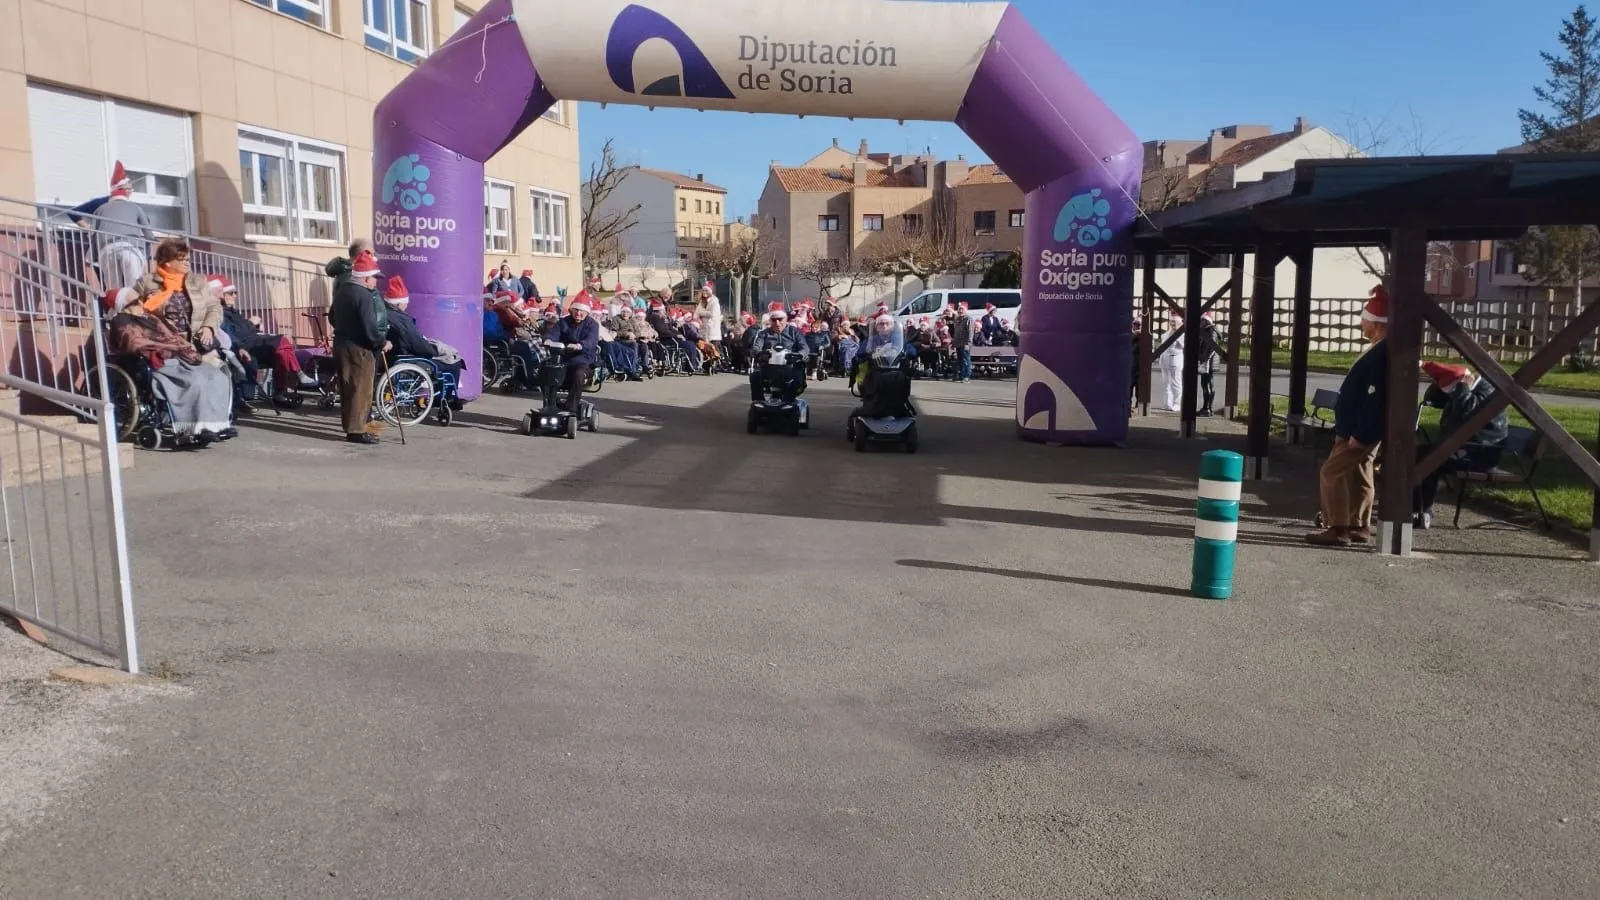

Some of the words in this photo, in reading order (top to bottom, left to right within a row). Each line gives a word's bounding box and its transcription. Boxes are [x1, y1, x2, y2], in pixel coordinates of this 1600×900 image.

[738, 35, 897, 70] Diputación
[738, 64, 771, 90] de
[780, 68, 854, 94] Soria
[375, 210, 411, 229] Soria
[415, 215, 457, 234] puro
[374, 229, 441, 251] Oxígeno
[409, 254, 429, 262] Soria
[1040, 248, 1088, 267] Soria
[1092, 252, 1127, 271] puro
[1039, 267, 1115, 290] Oxígeno
[1038, 291, 1074, 301] Diputación
[1074, 291, 1085, 300] de
[1085, 291, 1103, 300] Soria
